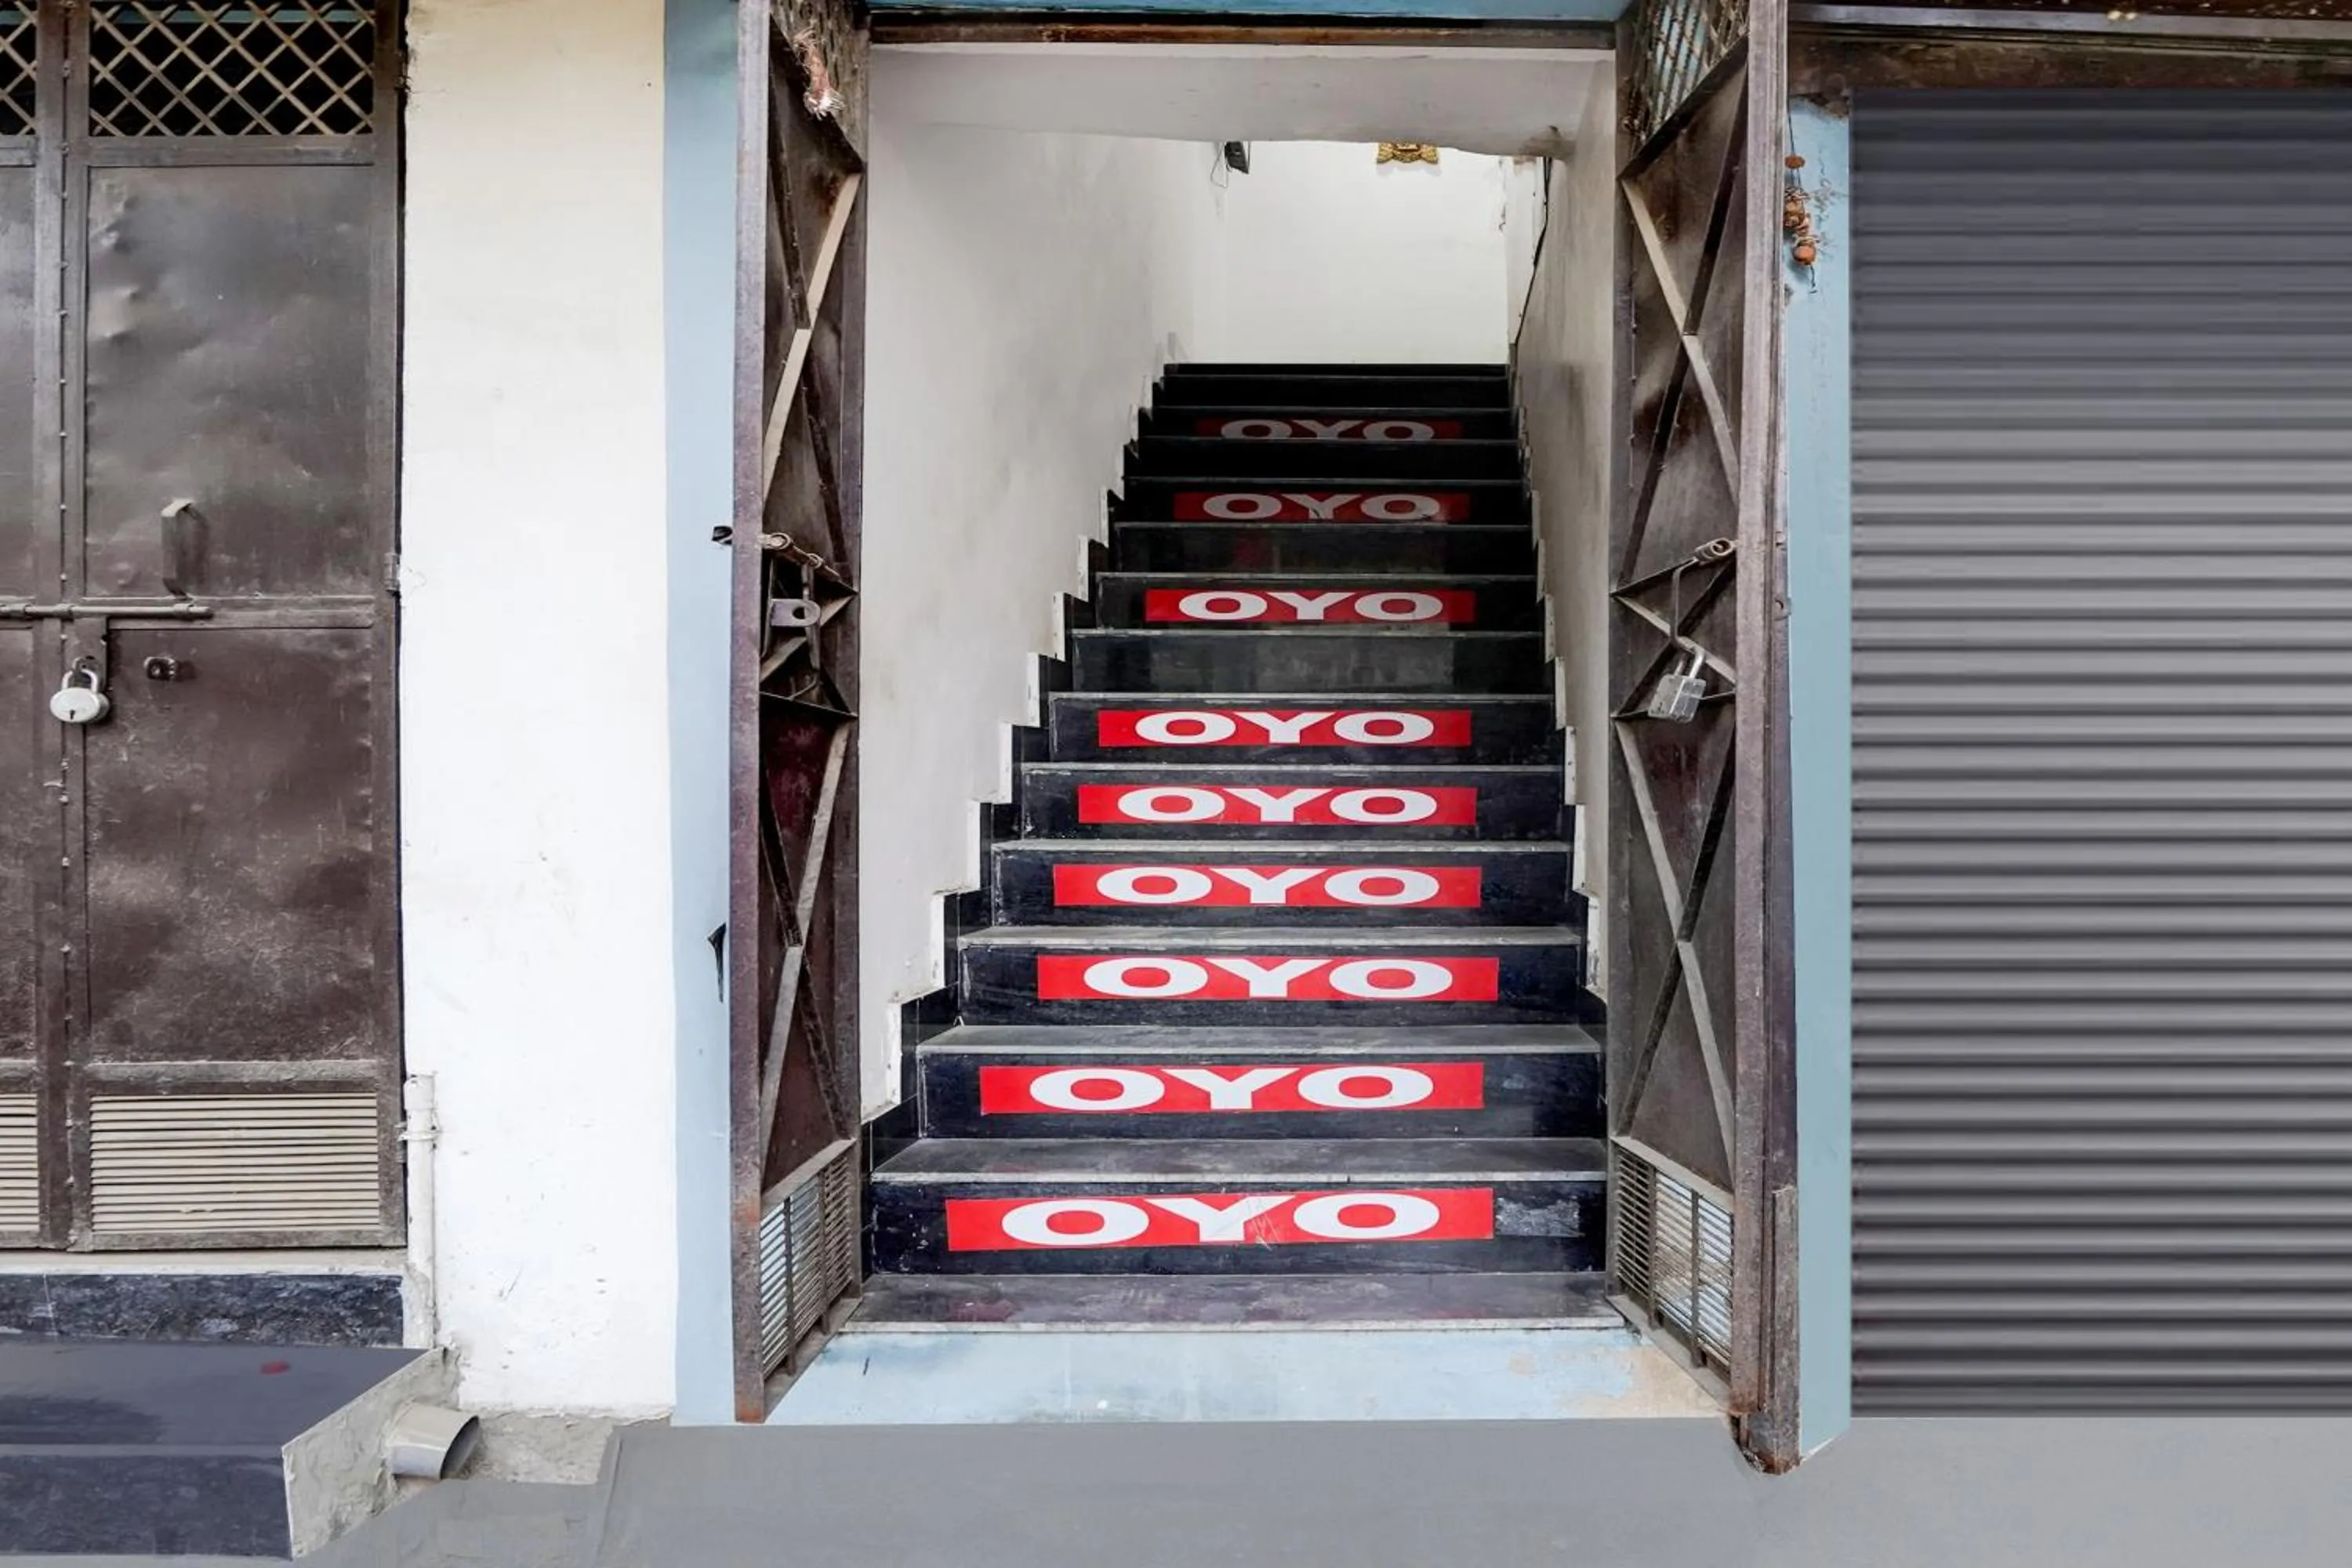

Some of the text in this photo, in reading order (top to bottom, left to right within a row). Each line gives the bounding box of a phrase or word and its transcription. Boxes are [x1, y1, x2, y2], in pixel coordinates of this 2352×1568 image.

[1221, 419, 1435, 439] OYO
[1203, 493, 1441, 520] OYO
[1179, 591, 1443, 620] OYO
[1135, 712, 1433, 743] OYO
[1118, 787, 1436, 822] OYO
[1097, 867, 1439, 905] OYO
[1084, 957, 1452, 999] OYO
[1030, 1065, 1433, 1110] OYO
[1002, 1193, 1439, 1245] OYO
